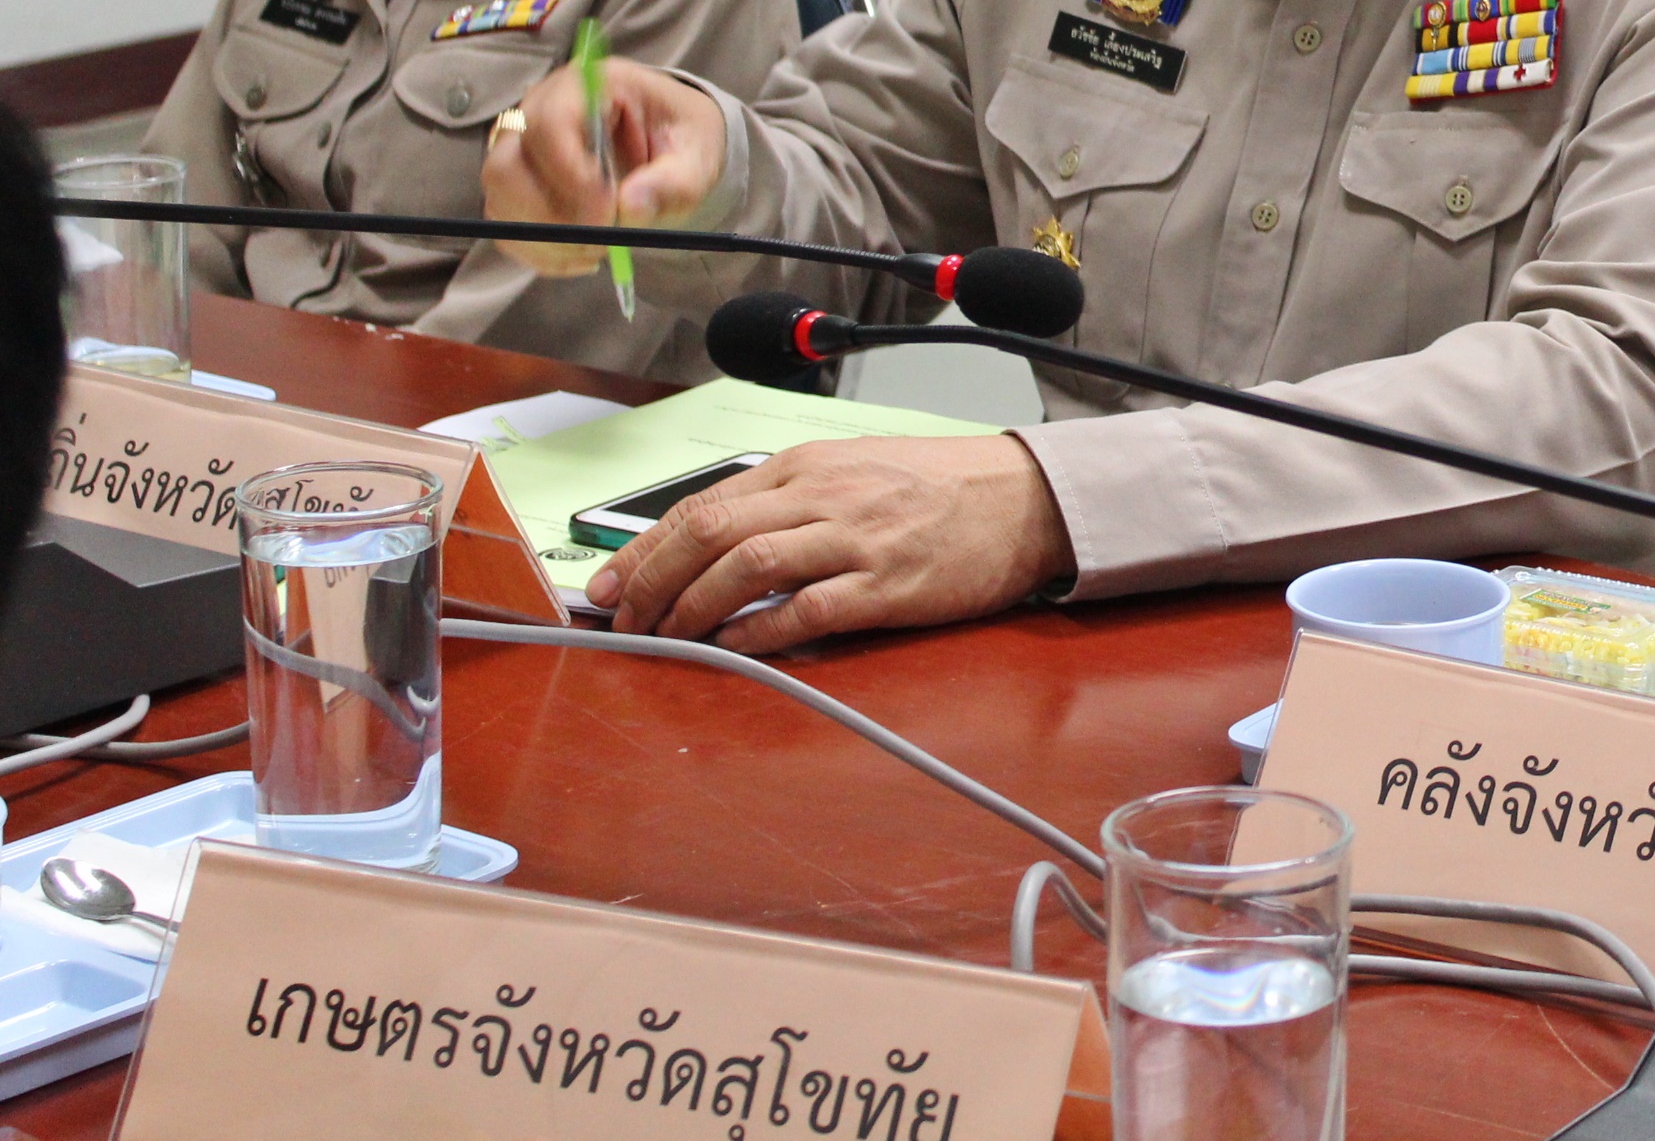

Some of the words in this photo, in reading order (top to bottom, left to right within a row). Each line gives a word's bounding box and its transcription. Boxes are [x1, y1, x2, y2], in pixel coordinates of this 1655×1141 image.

[245, 978, 960, 1141] เกษตรจังหวัดสุโขทัย
